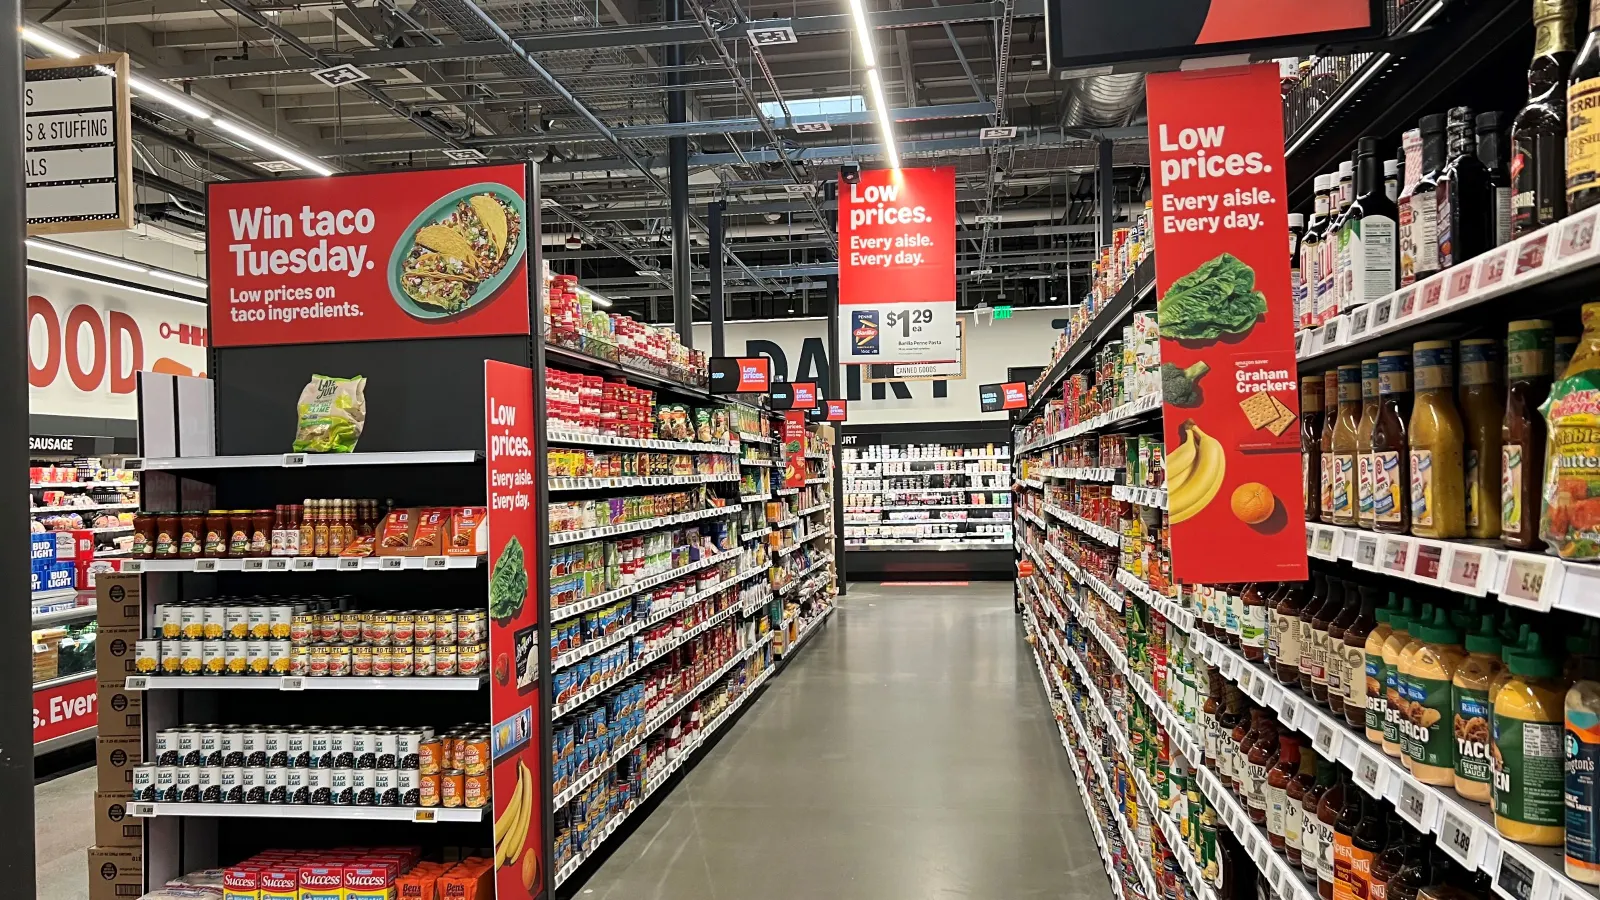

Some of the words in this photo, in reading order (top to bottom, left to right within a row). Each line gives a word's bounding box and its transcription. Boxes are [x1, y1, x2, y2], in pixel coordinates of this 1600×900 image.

[38, 122, 46, 140] &
[51, 118, 108, 140] STUFFING
[1159, 124, 1225, 151] Low
[1160, 150, 1272, 186] prices.
[851, 184, 898, 203] Low
[1162, 194, 1219, 212] Every
[1223, 187, 1276, 207] aisle.
[229, 205, 293, 241] Win
[300, 205, 375, 237] taco
[851, 203, 932, 230] prices.
[1163, 216, 1220, 234] Every
[1224, 211, 1264, 230] day.
[851, 236, 892, 250] Every
[895, 233, 934, 248] aisle.
[229, 240, 375, 278] Tuesday.
[851, 253, 893, 267] Every
[895, 252, 925, 266] day.
[230, 287, 262, 304] Low
[265, 285, 313, 308] prices
[315, 287, 336, 301] on
[230, 307, 266, 323] taco
[268, 302, 364, 323] ingredients.
[912, 325, 922, 333] ea
[743, 372, 765, 380] prices.
[896, 366, 917, 375] CANNED
[1236, 368, 1288, 382] Graham
[317, 386, 338, 399] JULY
[318, 379, 336, 391] LATE
[1236, 380, 1296, 393] Crackers
[491, 398, 516, 426] Low
[29, 437, 73, 451] SAUSAGE
[491, 429, 532, 461] prices.
[491, 470, 514, 489] Every
[515, 469, 534, 485] aisle.
[492, 493, 514, 511] Every
[515, 491, 530, 510] day.
[33, 541, 51, 551] BUD
[31, 549, 53, 559] LIGHT
[50, 570, 68, 580] BUD
[48, 578, 71, 588] LIGHT
[1522, 575, 1542, 594] 5.49
[50, 695, 98, 724] Ever
[1461, 702, 1488, 714] Ranch
[1463, 762, 1487, 772] SECRET
[1464, 768, 1486, 778] SAUCE
[1454, 828, 1470, 851] 3.89
[224, 875, 255, 887] Success
[262, 875, 294, 888] Success
[301, 872, 341, 885] Success
[346, 872, 385, 886] Success
